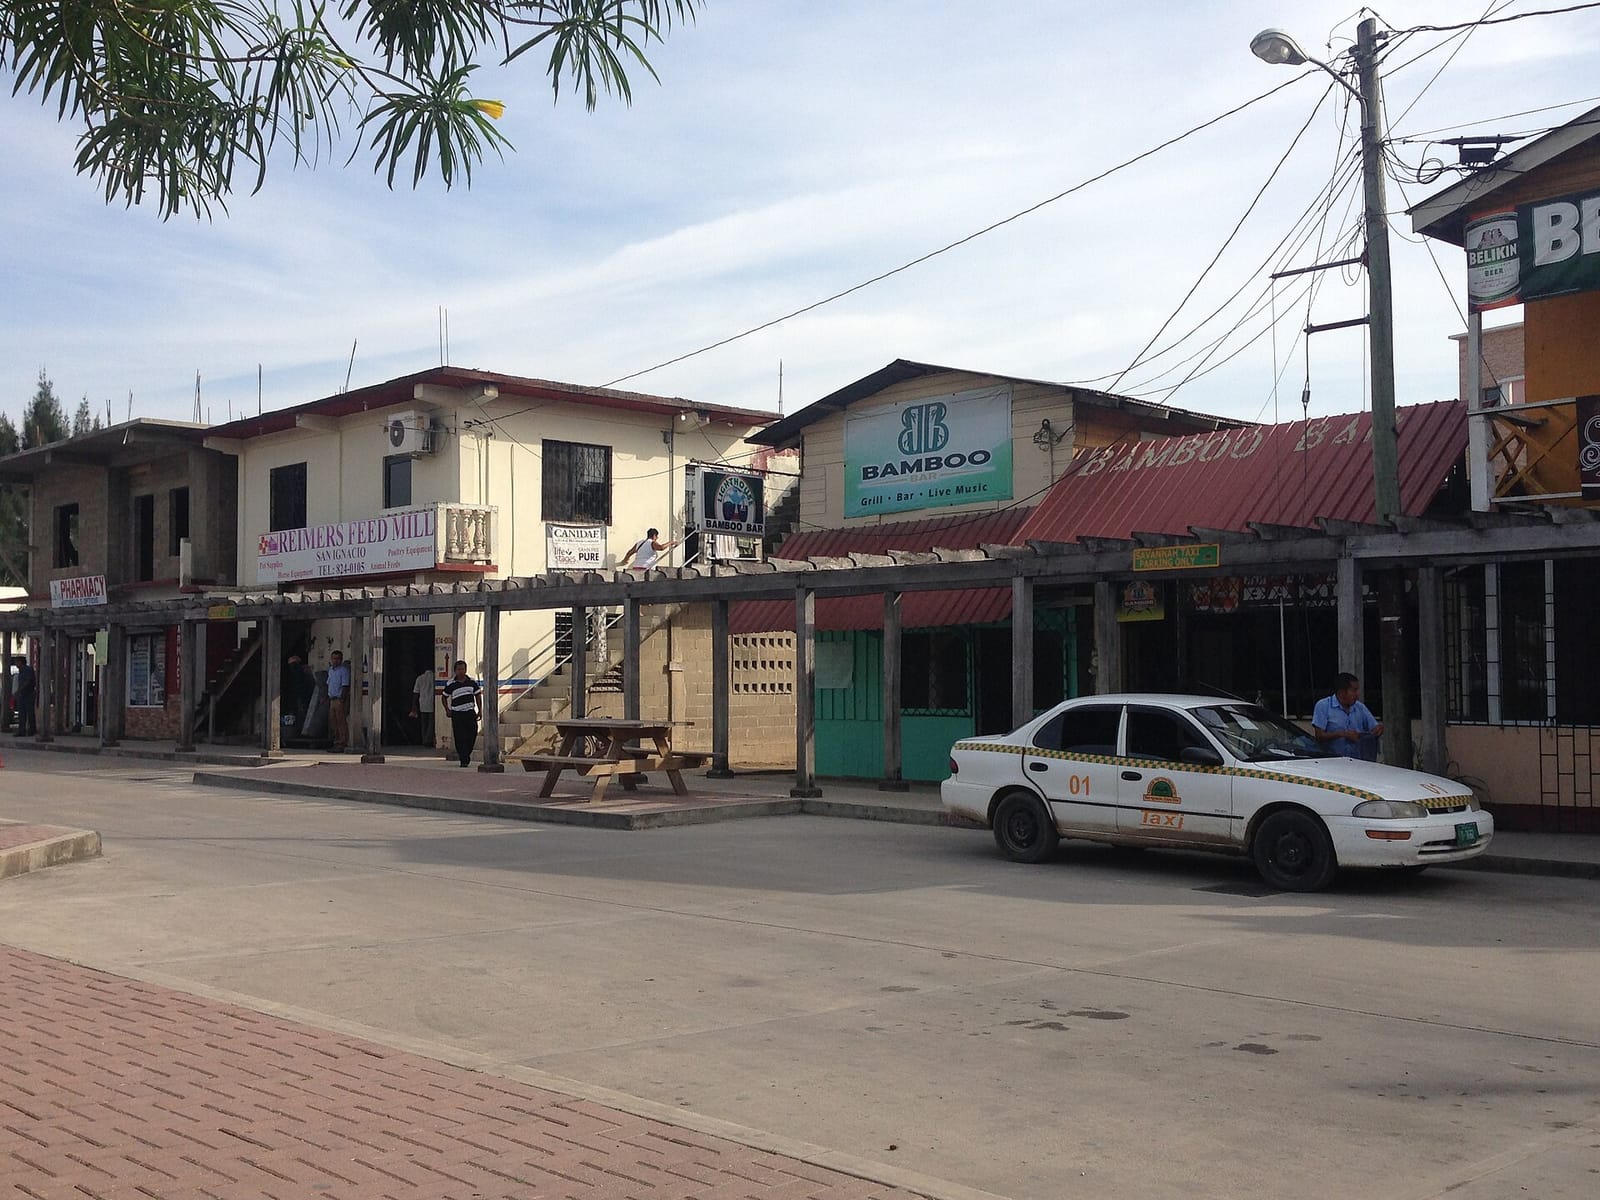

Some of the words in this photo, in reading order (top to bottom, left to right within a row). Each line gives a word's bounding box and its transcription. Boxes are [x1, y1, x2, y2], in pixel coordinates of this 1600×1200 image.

[1469, 243, 1517, 266] BELIKIN
[1484, 268, 1503, 277] BEER
[1077, 429, 1263, 477] BAMBOO
[862, 450, 991, 480] BAMBOO
[910, 472, 937, 483] BAR
[861, 496, 882, 506] Grill
[897, 492, 914, 501] Bar
[929, 488, 951, 497] Live
[955, 484, 988, 494] Music
[279, 524, 344, 553] REIMERS
[347, 519, 387, 546] FEED
[392, 512, 433, 541] MILL
[554, 529, 600, 538] CANIDAE
[705, 520, 743, 531] BAMBOO
[746, 523, 764, 534] BAR
[316, 550, 331, 562] SAN
[332, 547, 366, 560] IGNACIO
[579, 552, 599, 561] PURE
[1135, 549, 1178, 559] SAVANNAH
[1182, 548, 1200, 556] TAXI
[318, 565, 335, 576] TEL:
[336, 562, 365, 575] 824-0105
[1140, 559, 1172, 568] PARKING
[1175, 557, 1195, 566] ONLY
[61, 576, 104, 599] PHARMACY
[1069, 774, 1090, 796] 01
[1142, 809, 1184, 829] Taxi
